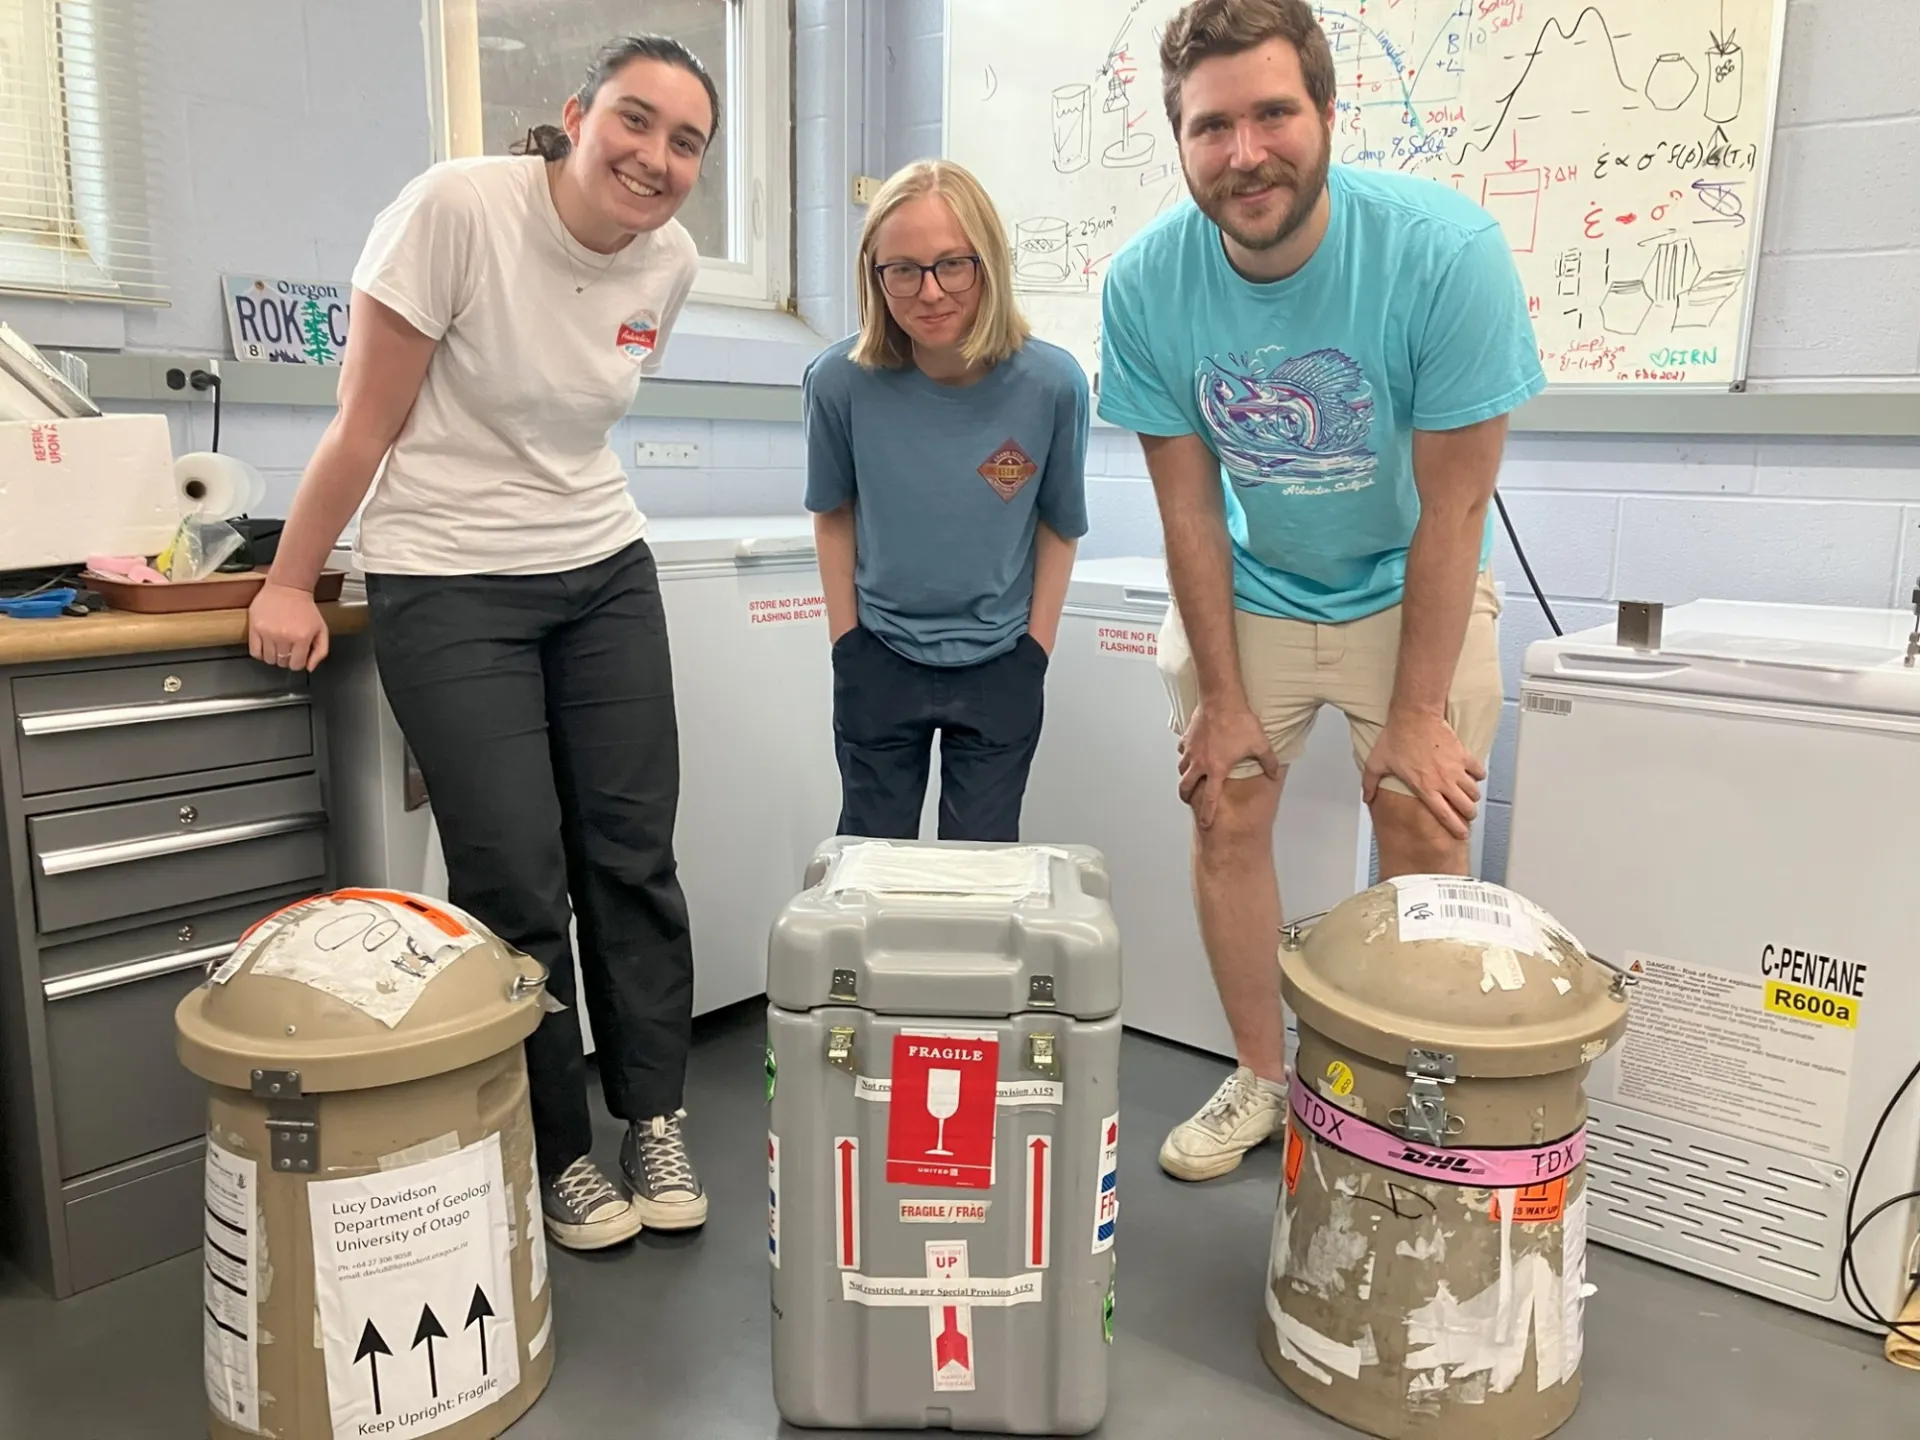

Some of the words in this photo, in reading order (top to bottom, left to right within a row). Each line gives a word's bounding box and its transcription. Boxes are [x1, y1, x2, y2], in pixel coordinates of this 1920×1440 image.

[1426, 105, 1466, 123] solid
[277, 280, 339, 300] Oregon
[235, 295, 306, 345] ROK
[327, 304, 350, 347] C
[249, 344, 259, 357] 8
[1670, 347, 1718, 366] FIRN
[47, 434, 62, 464] UPON
[749, 600, 777, 611] STORE
[779, 599, 791, 608] NO
[751, 612, 792, 624] FLASHING
[793, 609, 822, 620] BELOW
[1098, 628, 1129, 640] STORE
[1130, 631, 1145, 641] NO
[1100, 641, 1145, 655] FLASHING
[1761, 944, 1867, 998] C-PENTANE
[1774, 988, 1850, 1021] R600a
[908, 1045, 984, 1062] FRAGILE
[1032, 1087, 1055, 1097] A152
[1303, 1097, 1346, 1142] TDX
[1401, 1147, 1473, 1174] DHL
[1531, 1147, 1576, 1177] TDX
[332, 1199, 367, 1216] Lucy
[370, 1184, 438, 1210] Davidson
[334, 1205, 425, 1234] Department
[426, 1202, 442, 1217] of
[443, 1180, 492, 1209] Geology
[901, 1206, 945, 1217] FRAGILE
[1526, 1206, 1546, 1215] WAY
[1547, 1205, 1558, 1214] UP
[336, 1227, 410, 1253] University
[413, 1222, 429, 1237] of
[430, 1209, 471, 1232] Otago
[936, 1256, 958, 1268] UP
[849, 1281, 863, 1291] Not
[919, 1288, 935, 1297] per
[937, 1287, 969, 1297] Special
[970, 1288, 1012, 1297] Provision
[1013, 1283, 1035, 1295] A152
[357, 1414, 395, 1436] Keep
[398, 1398, 456, 1427] Upright:
[457, 1375, 499, 1405] Fragile
